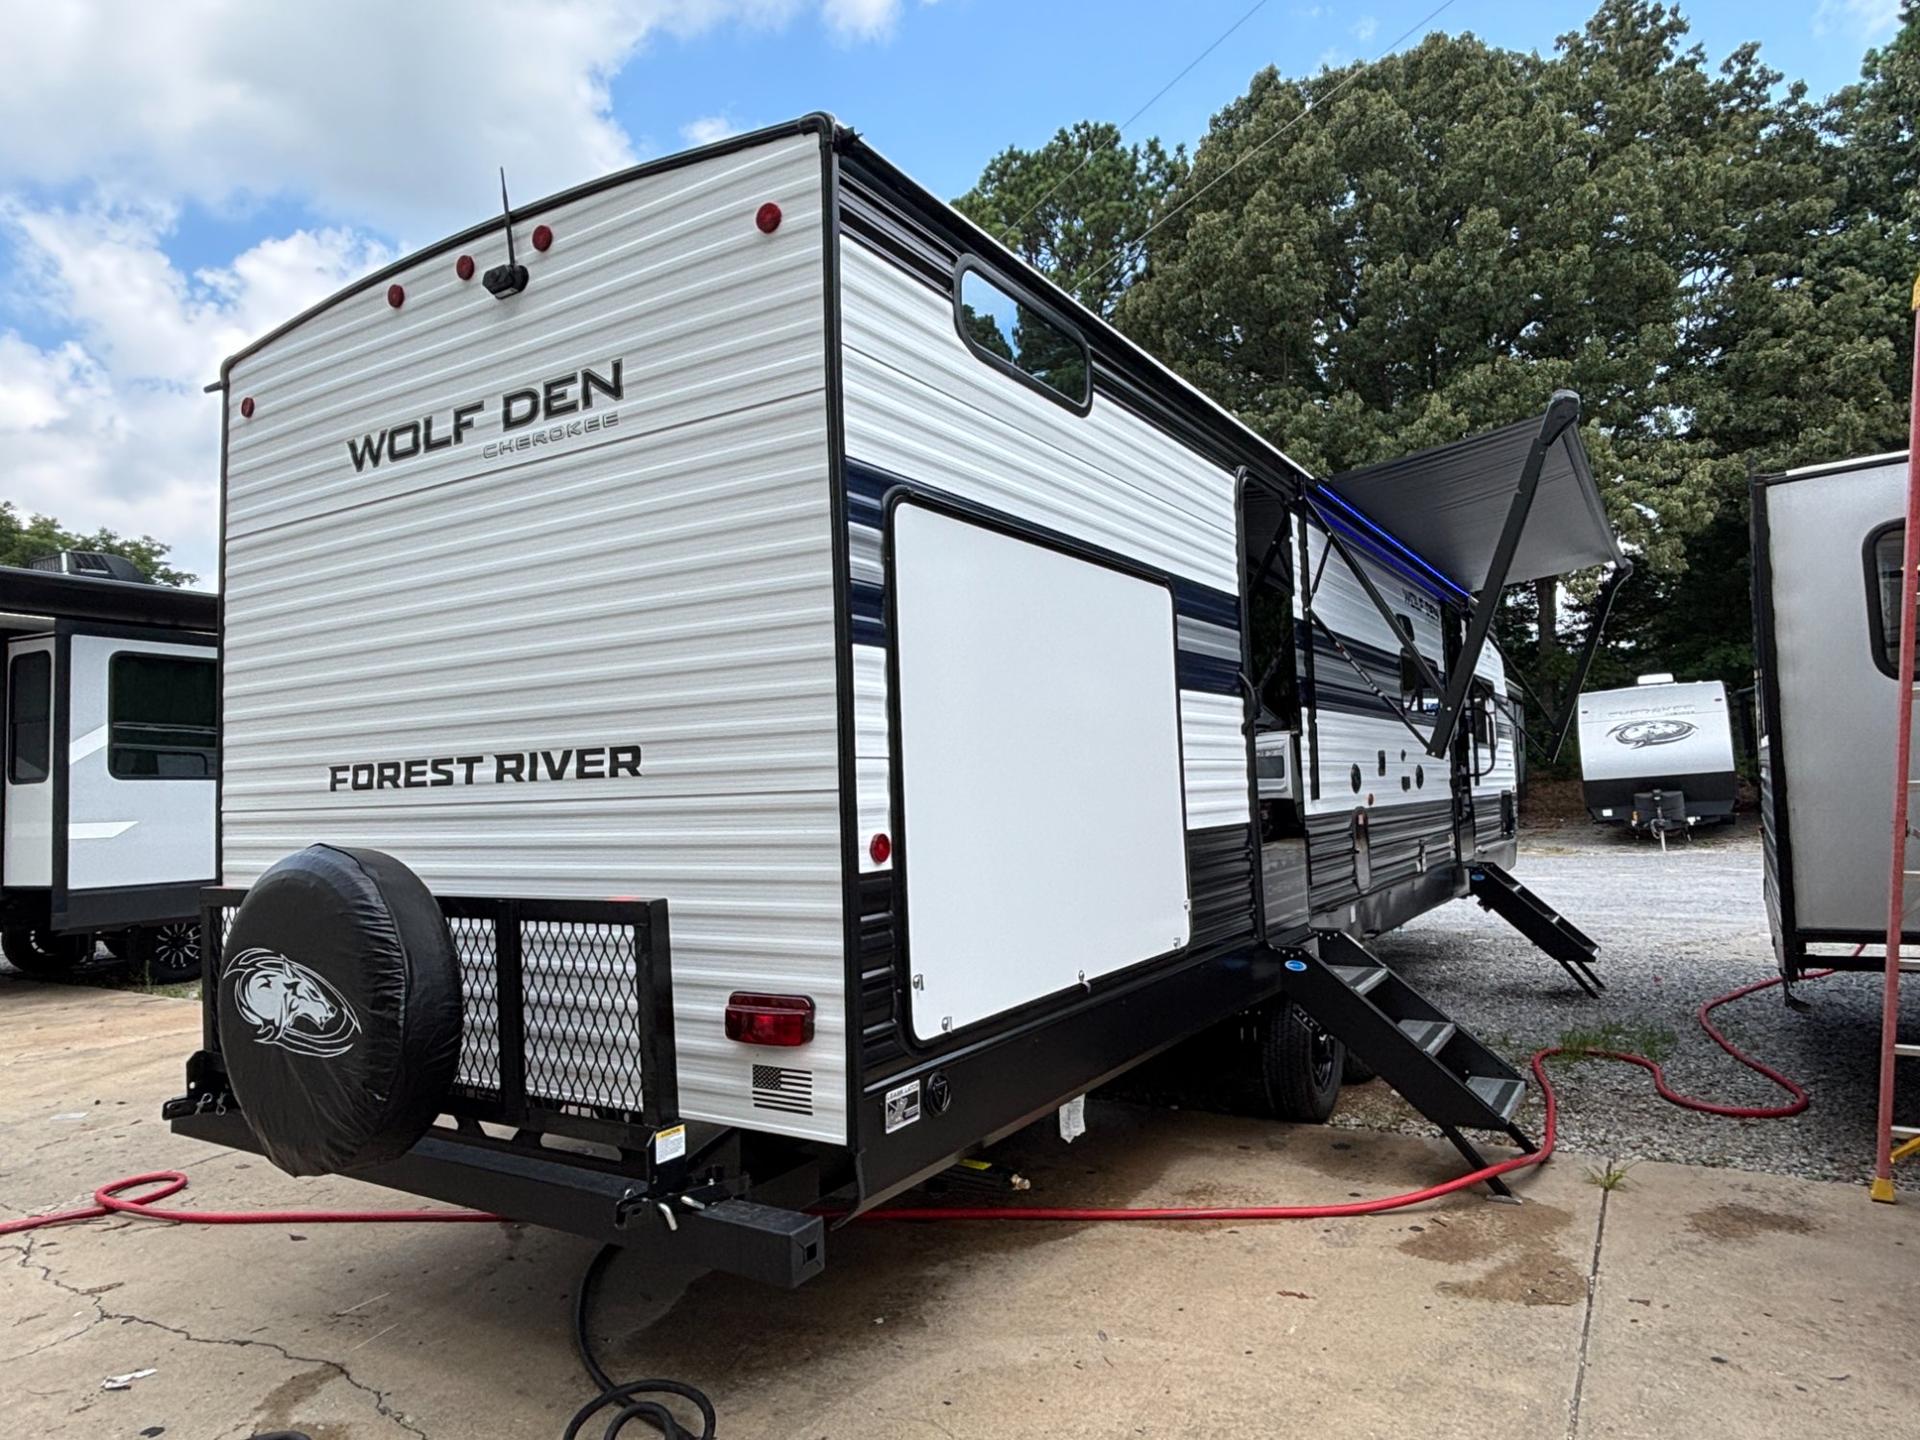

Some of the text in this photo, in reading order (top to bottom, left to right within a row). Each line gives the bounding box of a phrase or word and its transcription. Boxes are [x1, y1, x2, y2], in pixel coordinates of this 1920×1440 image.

[347, 358, 624, 472] WOLF DEN
[482, 411, 619, 459] CHEROKEE
[328, 745, 642, 792] FOREST RIVER
